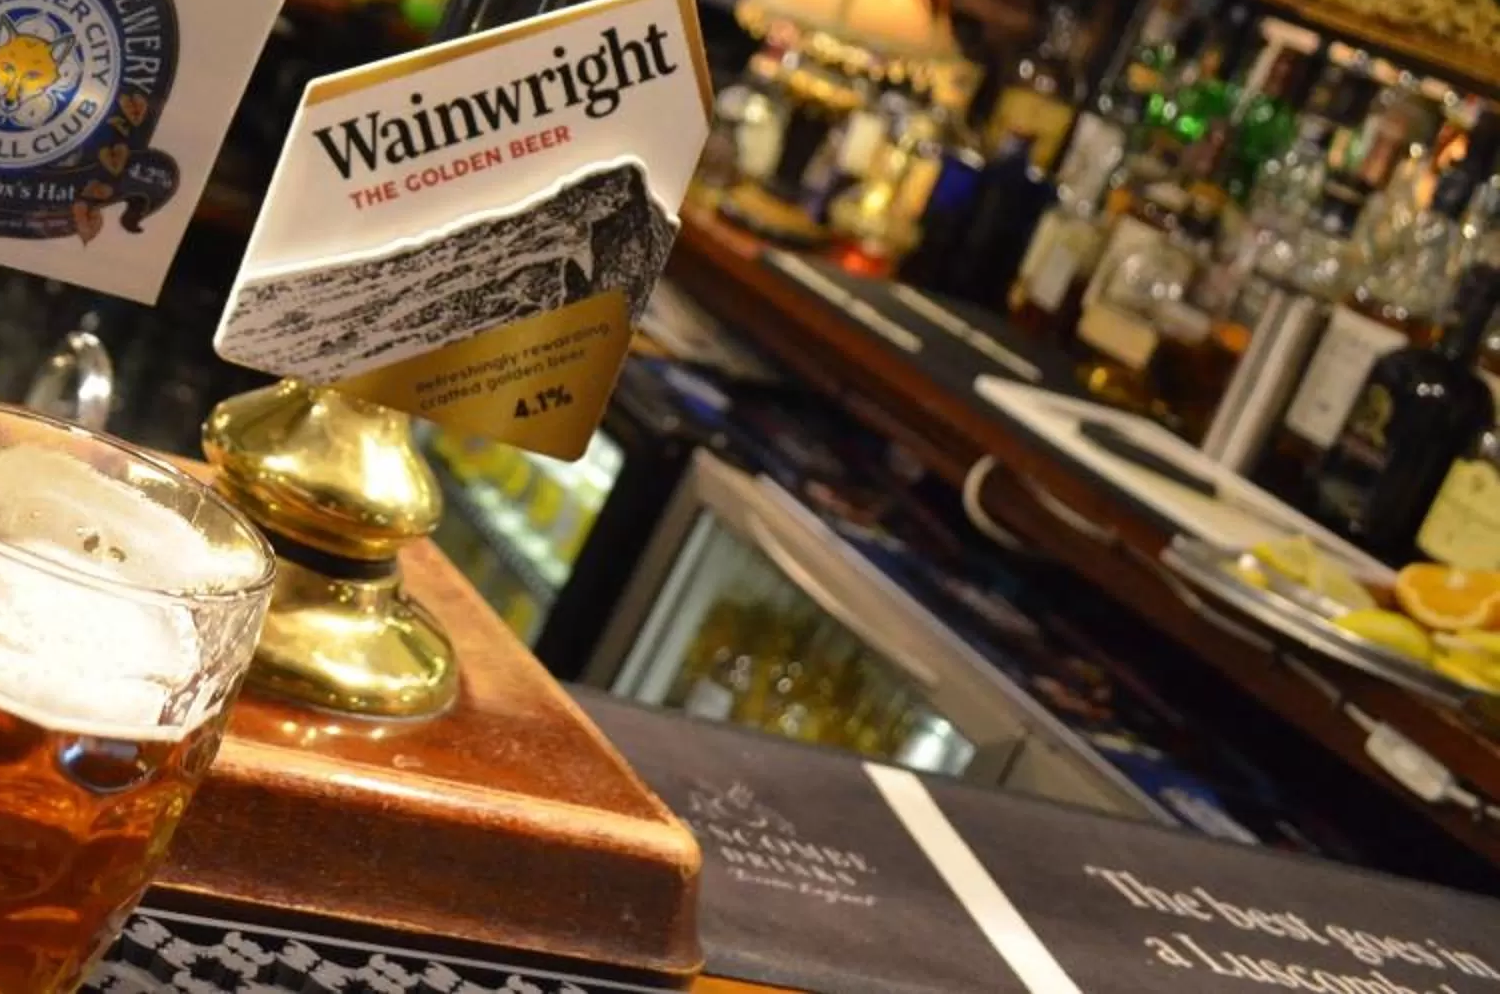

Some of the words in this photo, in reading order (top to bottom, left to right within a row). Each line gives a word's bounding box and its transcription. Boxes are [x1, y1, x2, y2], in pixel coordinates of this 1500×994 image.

[85, 22, 114, 87] CITY
[32, 99, 98, 155] CLUB
[314, 23, 678, 180] Wainwright
[36, 181, 77, 202] Hat
[350, 182, 398, 209] THE
[406, 149, 504, 193] GOLDEN
[510, 125, 572, 162] BEER
[487, 360, 545, 392] golden
[514, 384, 573, 418] 4.1%
[1084, 865, 1211, 920] The
[1192, 887, 1330, 945] best
[1326, 924, 1446, 967] goes
[1425, 938, 1500, 981] in
[1144, 936, 1192, 969] a
